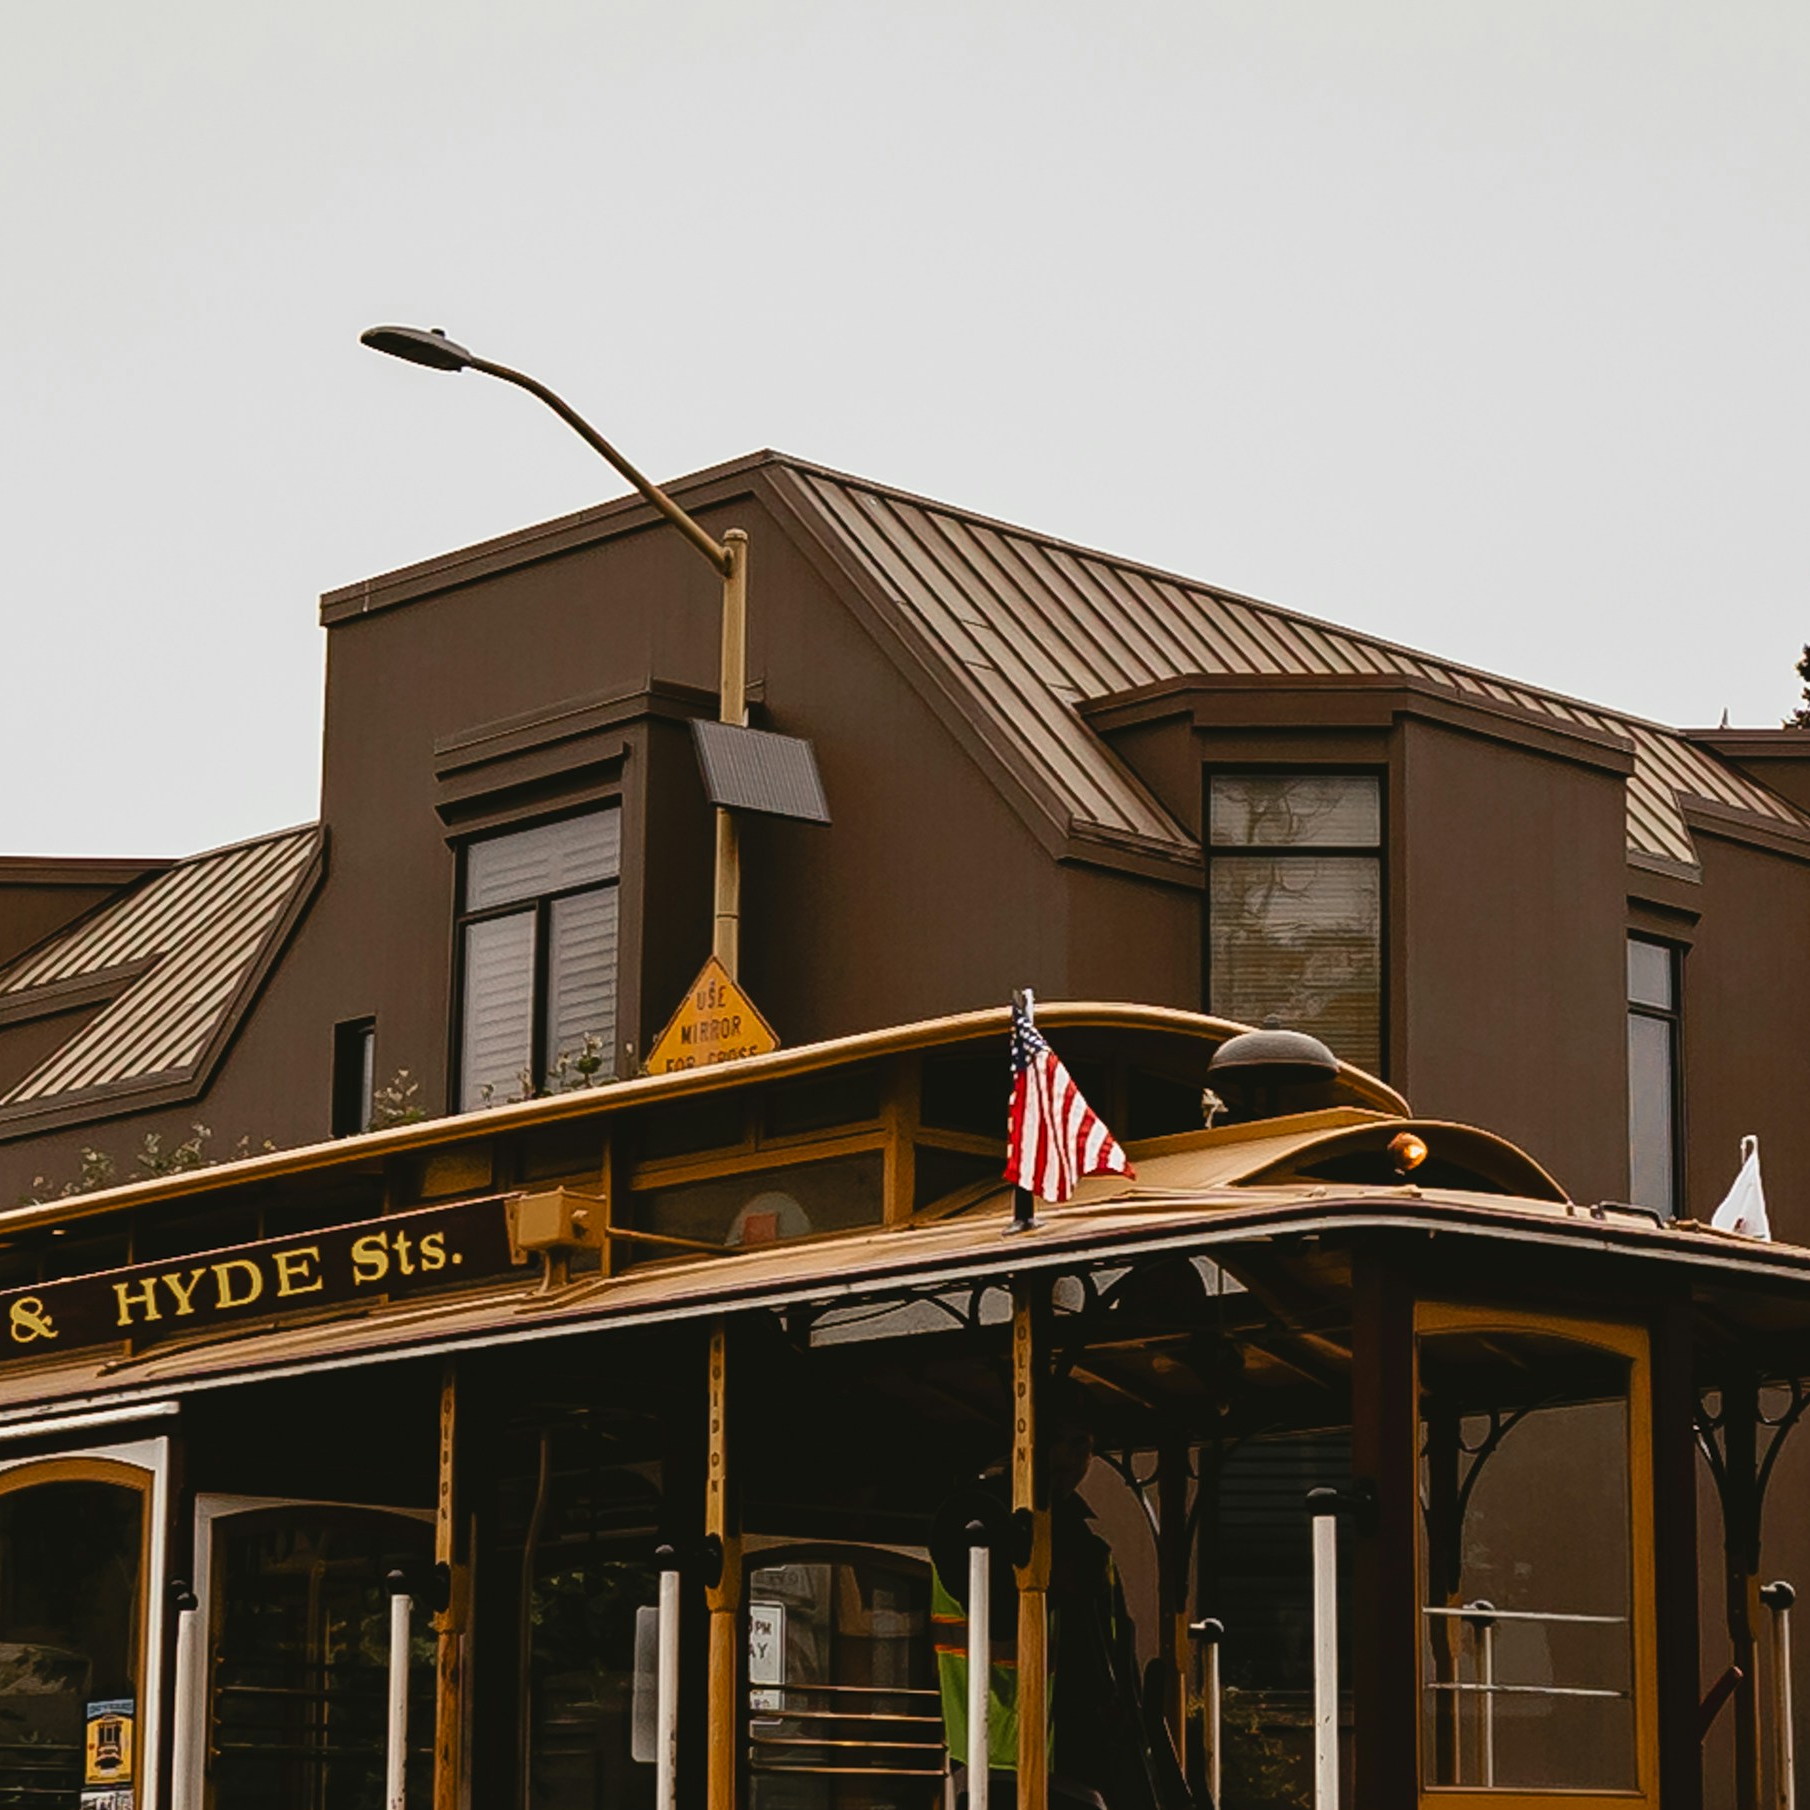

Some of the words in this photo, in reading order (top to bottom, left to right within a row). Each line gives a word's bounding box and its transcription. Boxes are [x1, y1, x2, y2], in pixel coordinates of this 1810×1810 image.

[696, 985, 726, 1010] USE
[680, 1016, 741, 1044] MIRROR
[9, 1296, 59, 1343] &
[112, 1246, 324, 1327] HYDE
[351, 1229, 463, 1286] Sts.
